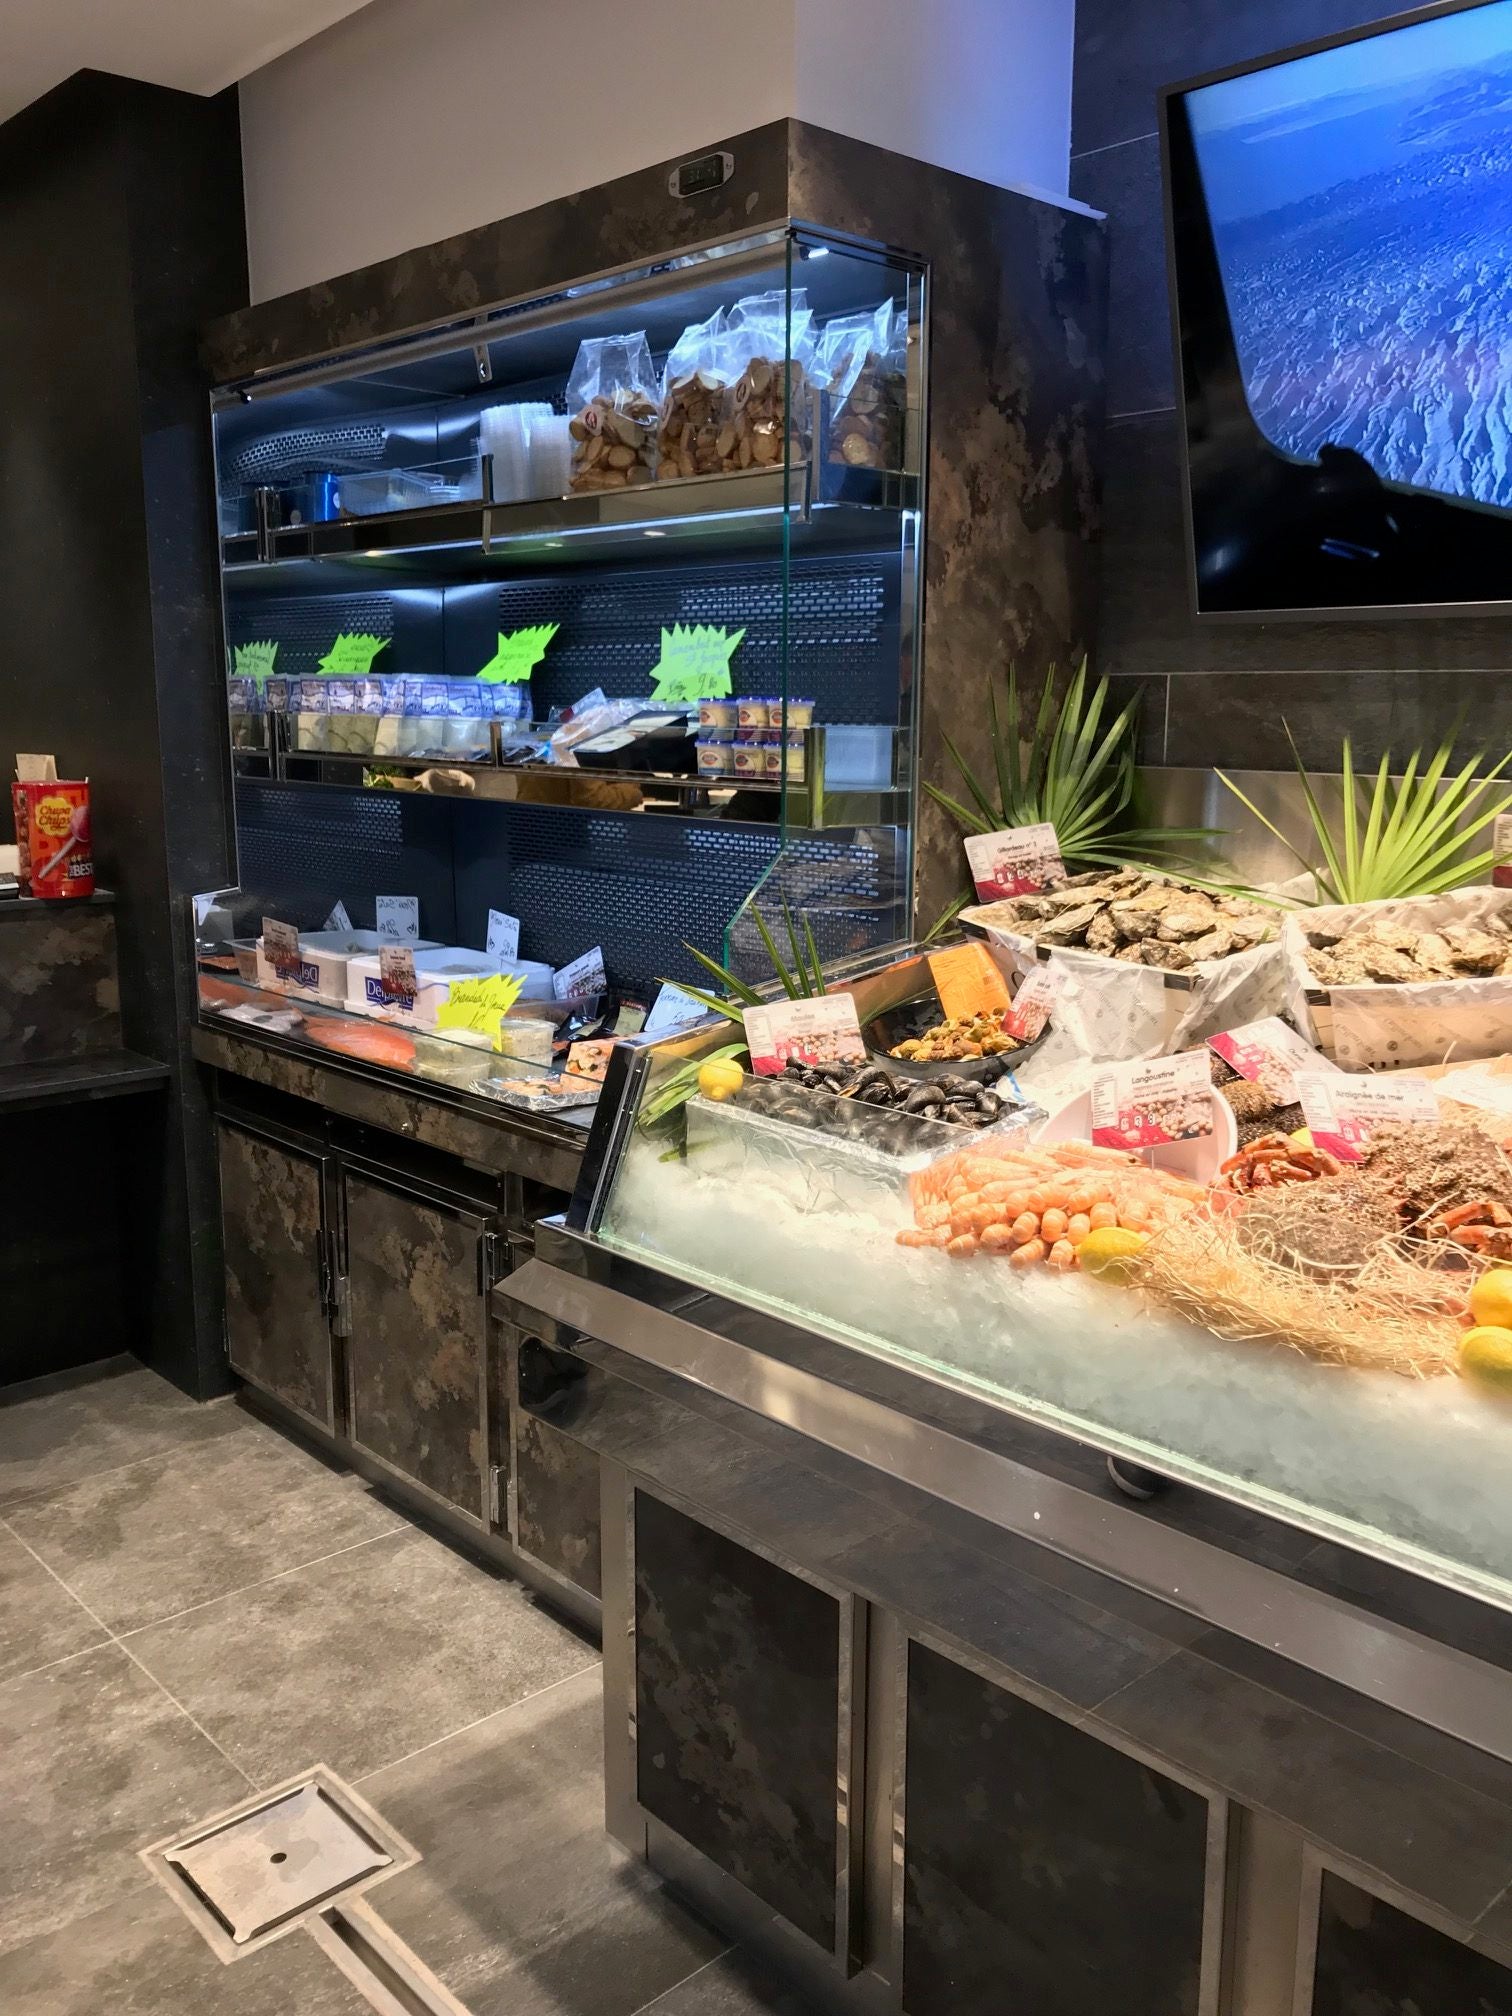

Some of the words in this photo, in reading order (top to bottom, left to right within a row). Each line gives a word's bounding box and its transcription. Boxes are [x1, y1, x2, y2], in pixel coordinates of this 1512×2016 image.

[39, 805, 71, 817] Chupa
[74, 862, 94, 877] BEST
[1131, 1070, 1175, 1084] Langoustine
